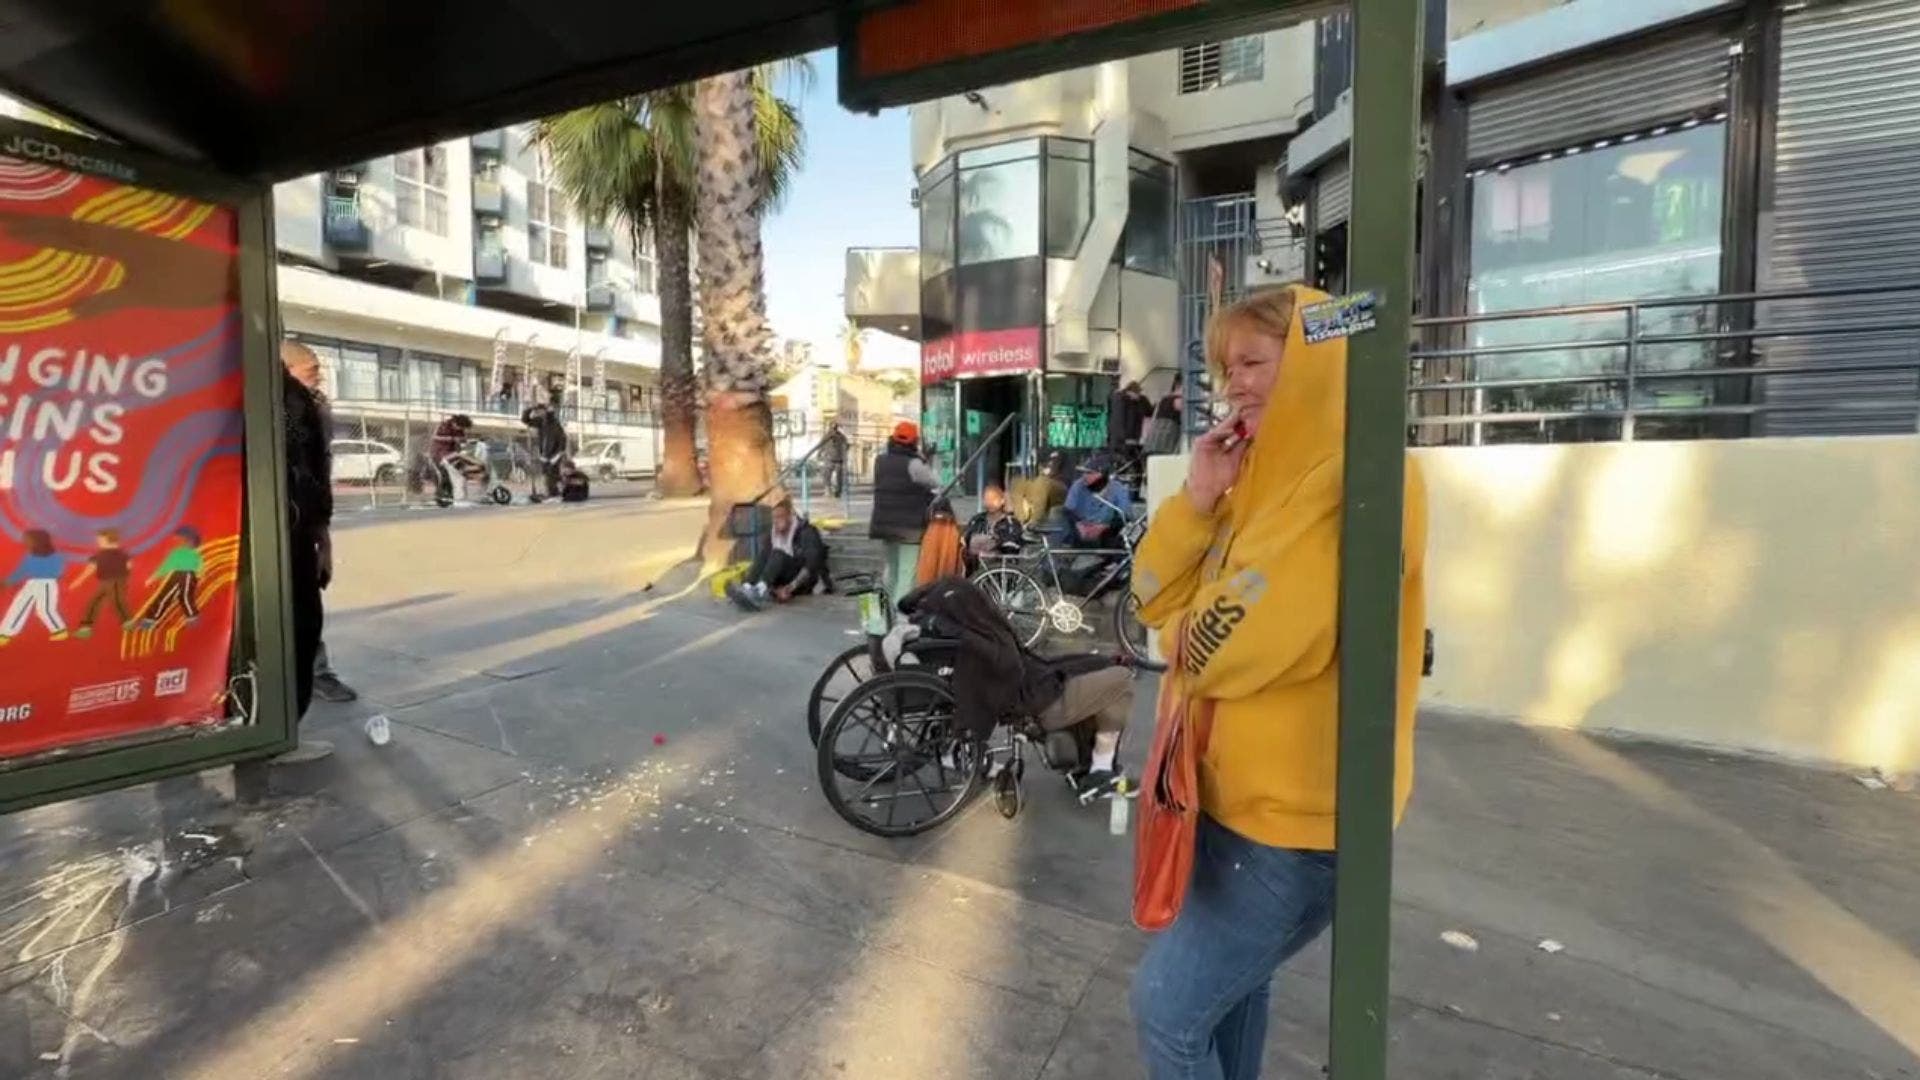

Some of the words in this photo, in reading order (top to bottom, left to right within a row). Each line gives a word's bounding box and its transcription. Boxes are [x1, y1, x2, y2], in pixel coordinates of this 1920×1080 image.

[924, 341, 955, 375] total
[962, 346, 1033, 367] wireless
[0, 394, 125, 445] INS
[43, 450, 120, 493] US
